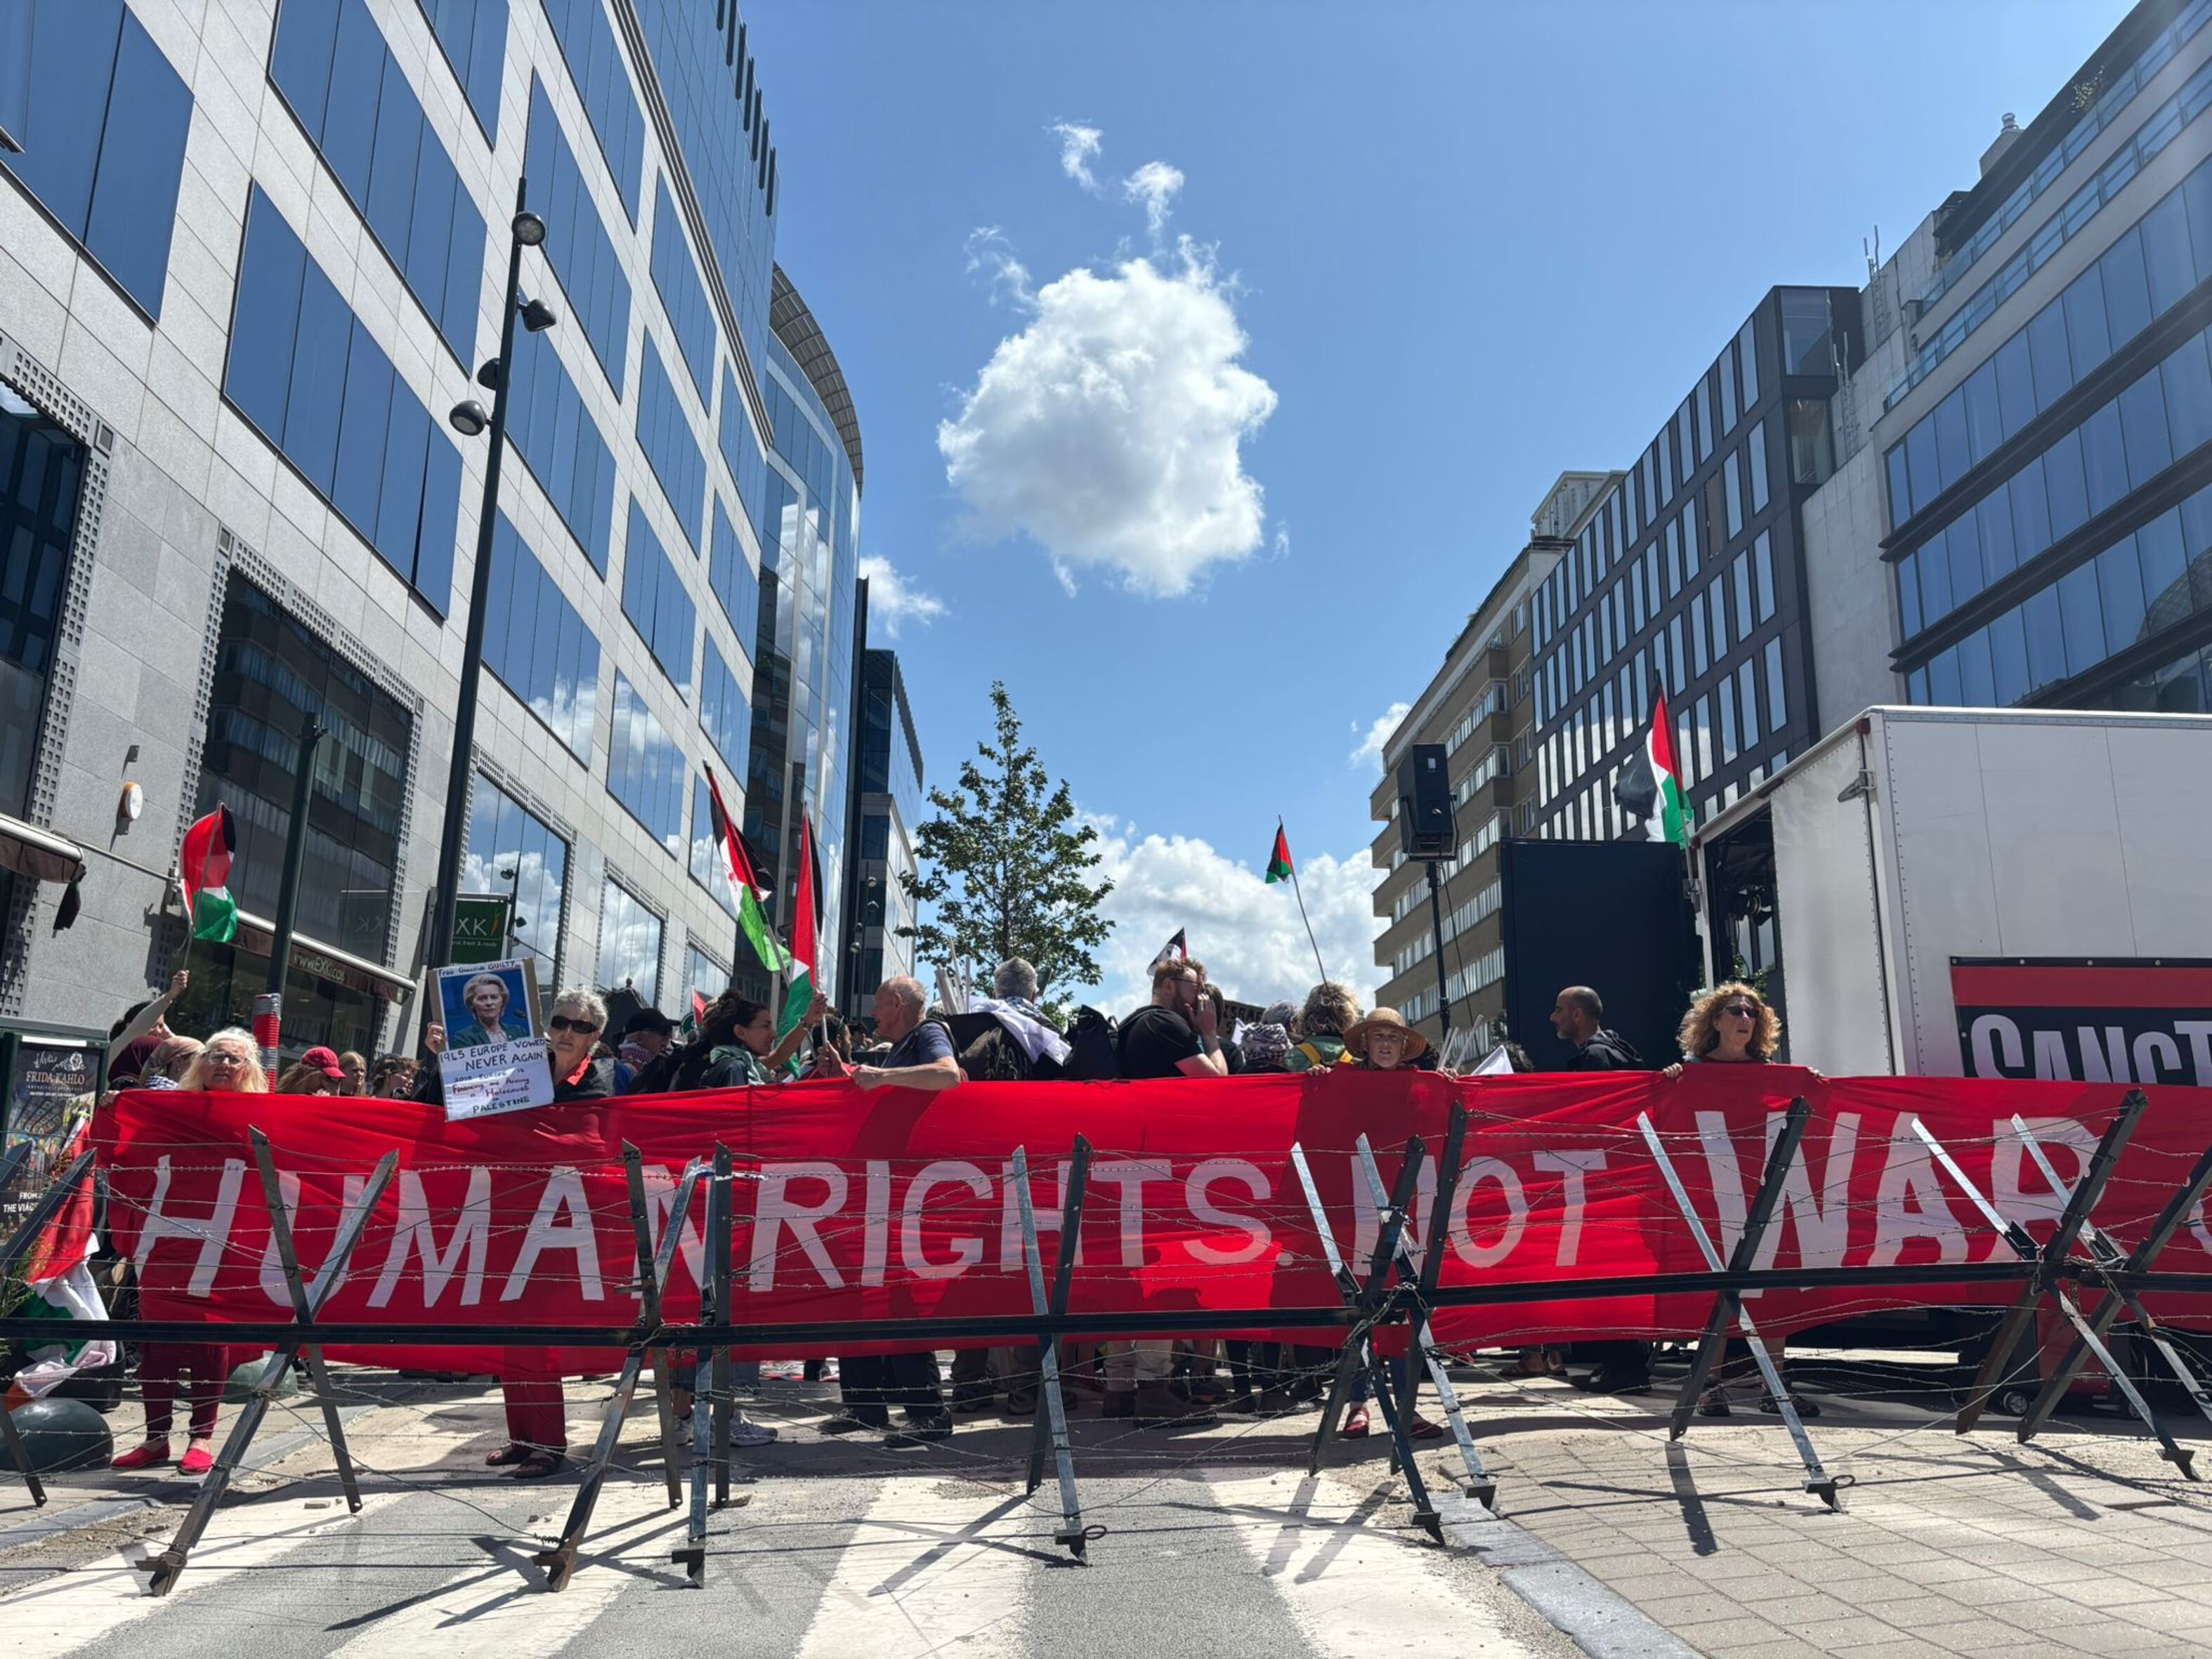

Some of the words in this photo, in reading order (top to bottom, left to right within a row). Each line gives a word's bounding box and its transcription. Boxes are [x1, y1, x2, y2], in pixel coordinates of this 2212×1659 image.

[471, 1043, 508, 1056] EUROPE
[514, 1040, 546, 1049] VOWED
[466, 1055, 507, 1071] NEVER
[26, 1071, 53, 1082] FRIDA
[55, 1073, 85, 1085] KAHLO
[486, 1085, 530, 1097] Holocaust
[473, 1096, 530, 1113] PALESTINE
[3, 1203, 17, 1213] THE
[134, 1153, 714, 1309] HUMAN
[1351, 1148, 1607, 1276] NOT
[1694, 1110, 2107, 1298] WAR
